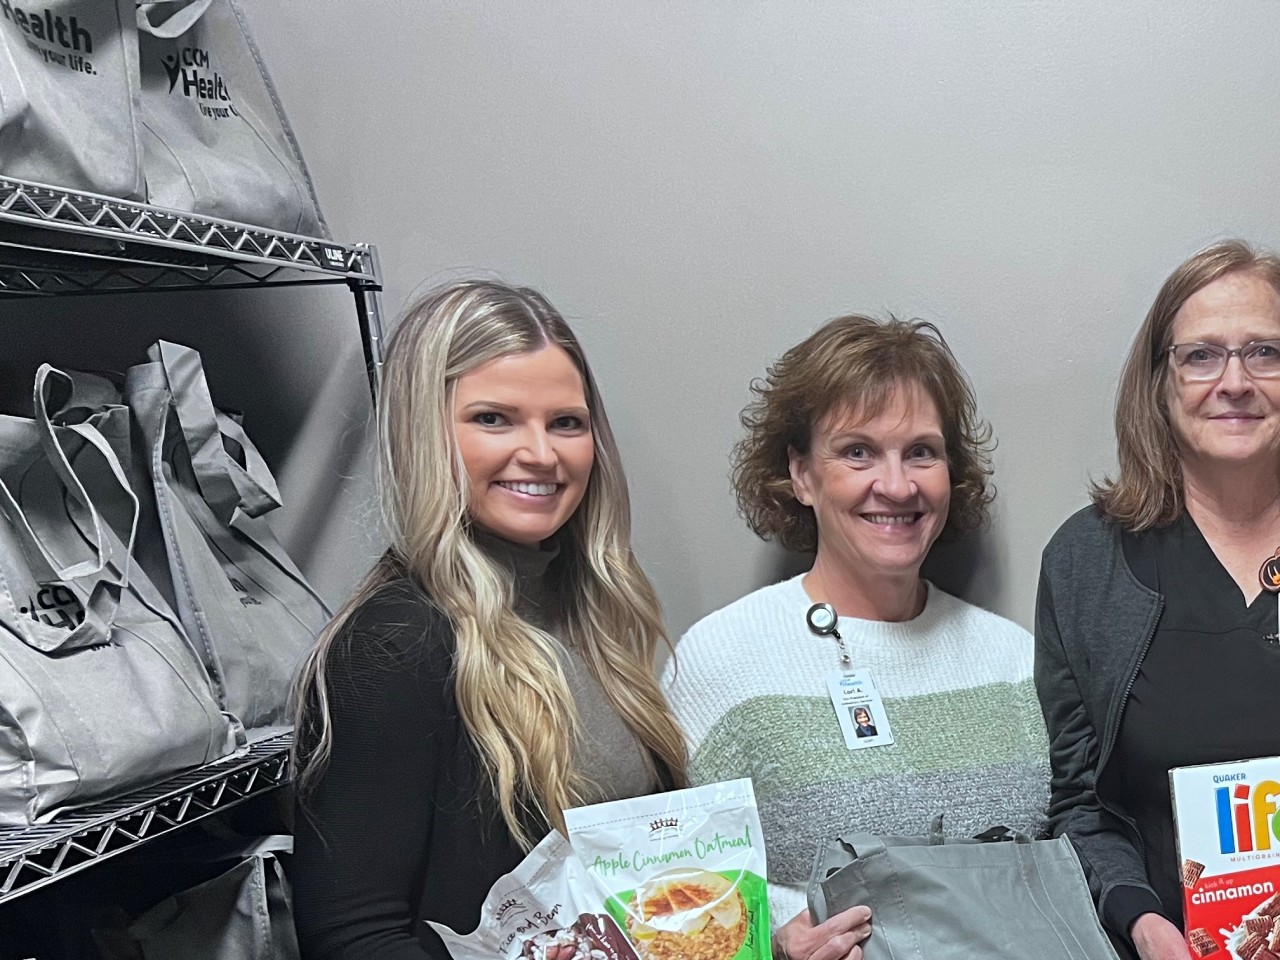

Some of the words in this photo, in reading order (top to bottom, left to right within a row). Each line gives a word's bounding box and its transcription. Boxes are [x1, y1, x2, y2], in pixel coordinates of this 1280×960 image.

[68, 53, 97, 76] life.
[182, 47, 209, 69] CCM
[1212, 772, 1247, 784] QUAKER
[592, 851, 630, 877] Apple
[633, 848, 693, 872] Cinnamon
[694, 824, 752, 860] Oatmeal
[1230, 852, 1280, 862] MULTIGRAIN
[1191, 881, 1274, 905] cinnamon
[516, 917, 540, 935] and
